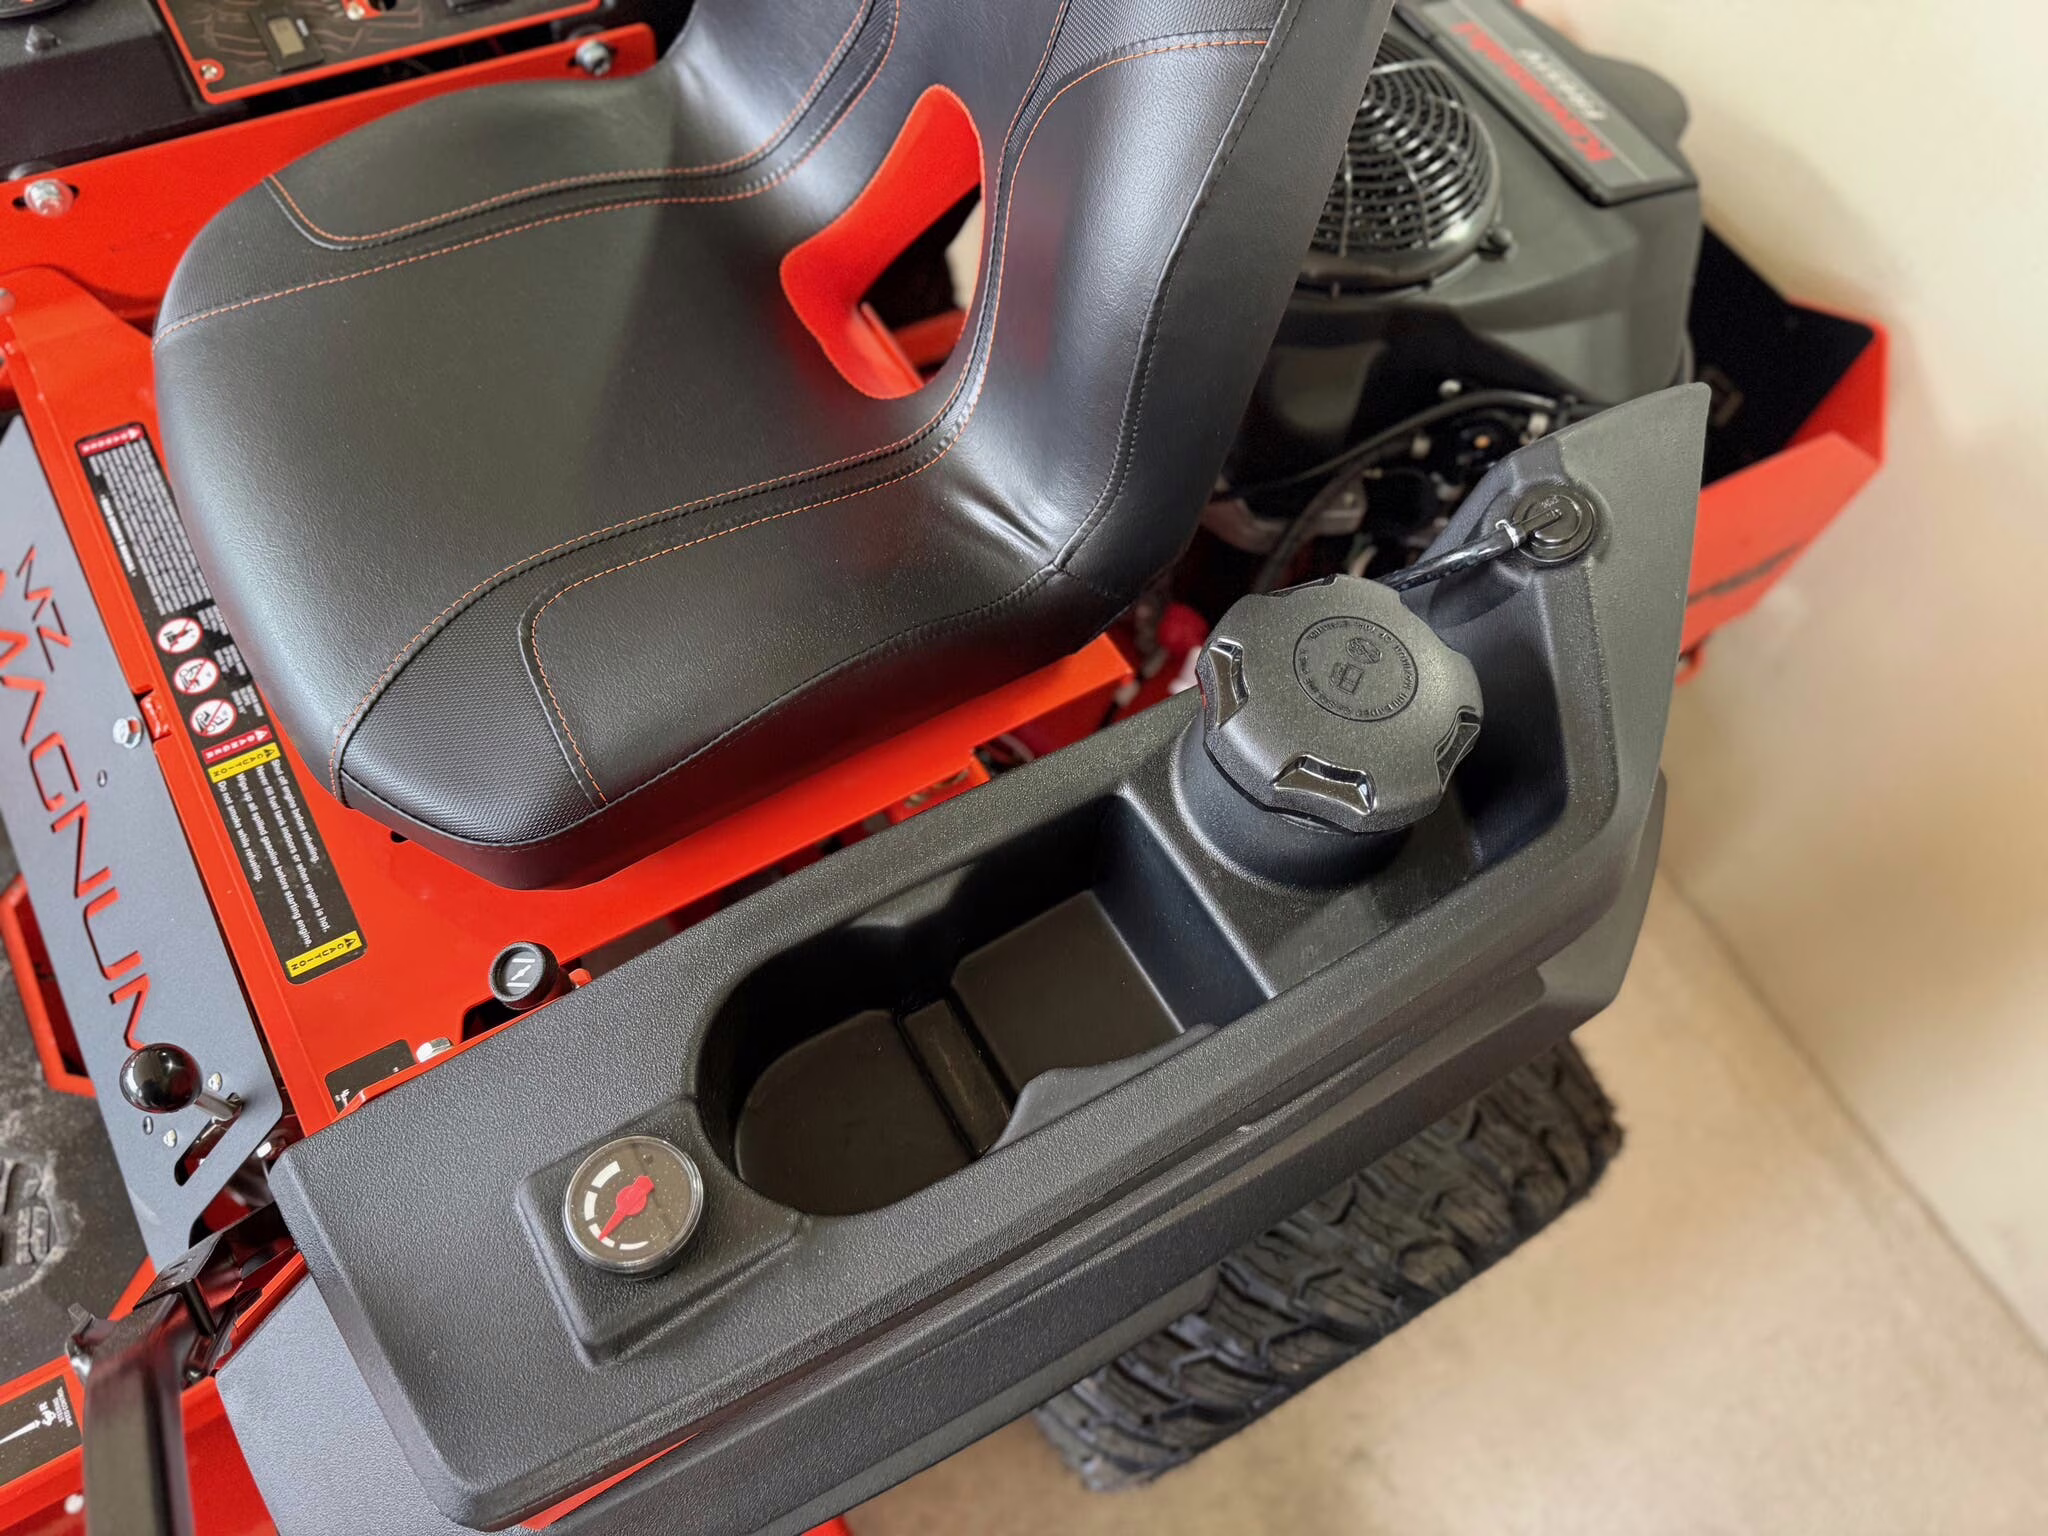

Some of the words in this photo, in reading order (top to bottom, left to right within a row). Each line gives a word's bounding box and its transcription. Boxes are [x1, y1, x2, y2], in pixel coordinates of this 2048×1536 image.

[16, 544, 72, 672] MZ
[206, 735, 255, 759] DANGER
[213, 753, 264, 777] CAUTION
[255, 765, 269, 786] Never
[271, 759, 284, 776] Shut
[217, 778, 227, 792] Do
[236, 772, 249, 792] Wipe
[264, 786, 275, 796] fill
[278, 775, 289, 786] off
[222, 792, 233, 805] not
[243, 792, 253, 802] up
[247, 802, 258, 812] all
[268, 795, 280, 810] fuel
[282, 783, 297, 809] engine
[227, 805, 242, 829] smoke
[251, 812, 268, 836] spilled
[274, 809, 286, 827] tank
[291, 807, 306, 831] before
[237, 828, 250, 848] while
[280, 826, 297, 854] indoors
[301, 831, 319, 864] refueling.
[260, 836, 279, 866] gasoline
[292, 854, 301, 862] or
[244, 848, 263, 882] refueling.
[296, 863, 310, 883] when
[274, 865, 289, 890] before
[284, 890, 301, 920] starting
[304, 883, 320, 908] engine
[315, 908, 324, 917] is
[296, 919, 312, 947] engine.
[318, 916, 331, 932] hot.
[291, 942, 344, 971] CAUTION
